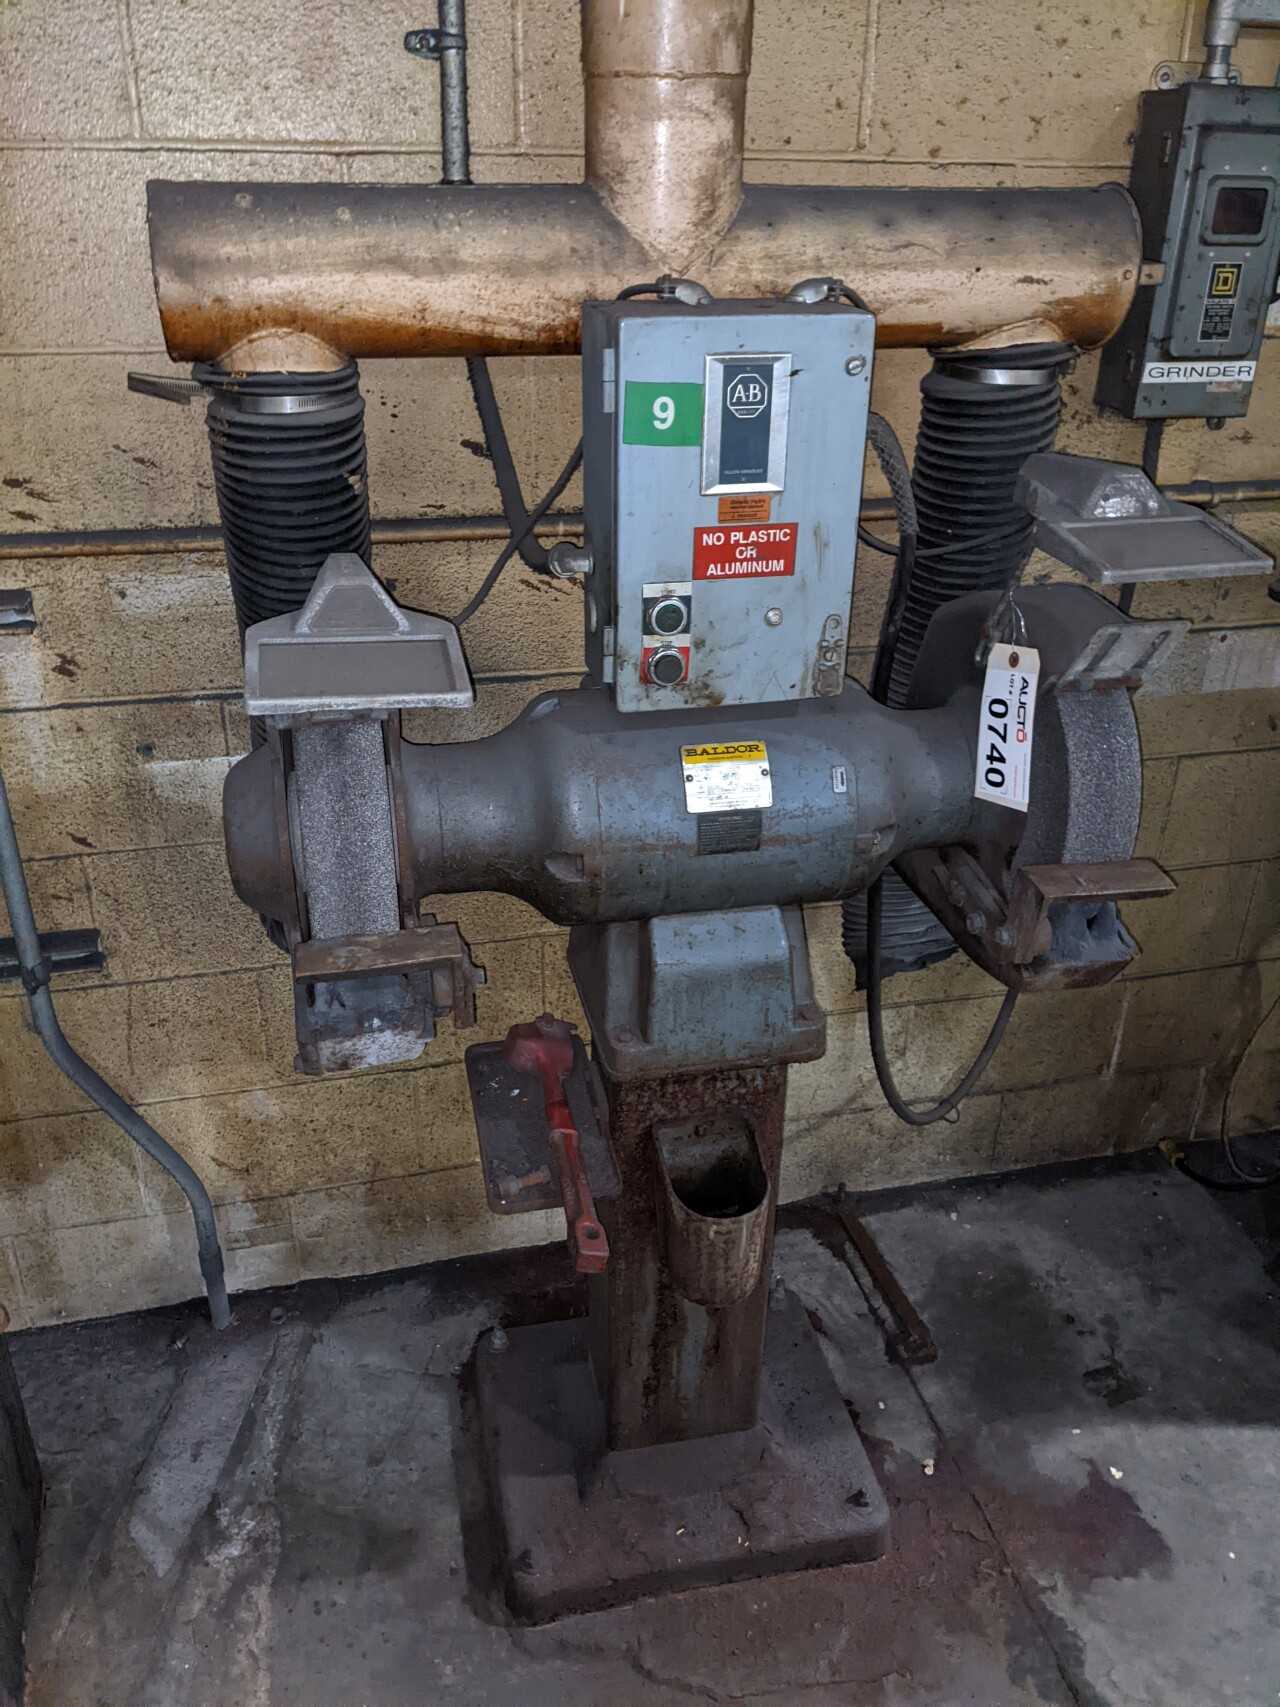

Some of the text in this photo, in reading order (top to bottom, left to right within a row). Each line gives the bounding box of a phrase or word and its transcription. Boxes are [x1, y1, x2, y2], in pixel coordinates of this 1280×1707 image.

[1148, 365, 1253, 379] GRINDER
[732, 383, 762, 403] A-B
[652, 396, 676, 430] 9
[702, 529, 790, 546] NO PLASTIC
[735, 546, 757, 559] OR
[706, 559, 785, 576] ALUMINUM
[685, 744, 762, 757] BALDOR
[984, 698, 1009, 788] 0740
